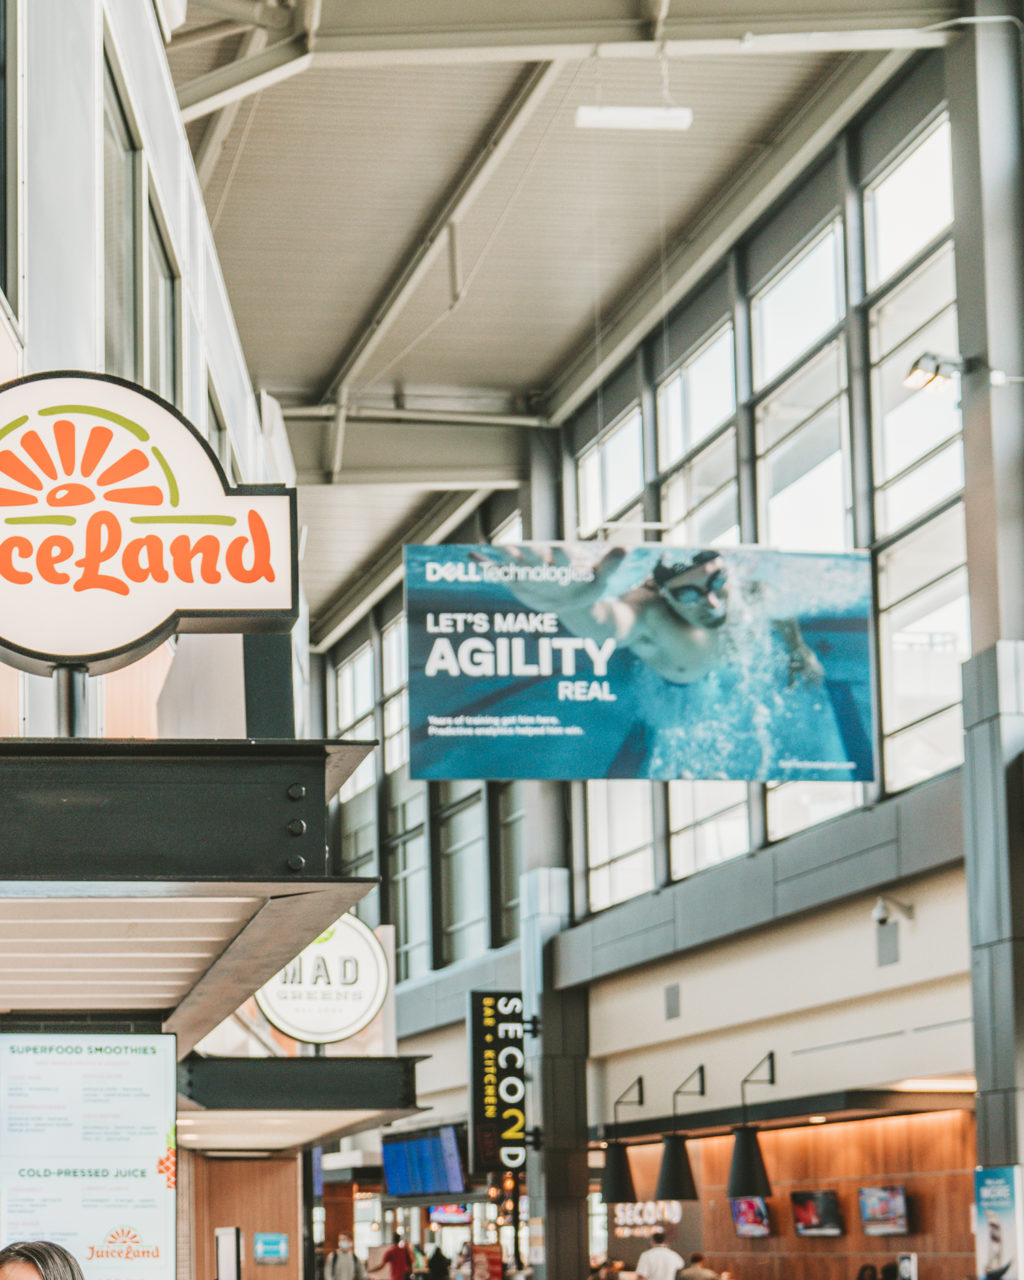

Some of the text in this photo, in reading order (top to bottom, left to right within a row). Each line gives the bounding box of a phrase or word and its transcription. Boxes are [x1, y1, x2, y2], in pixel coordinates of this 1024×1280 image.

[480, 561, 595, 585] Technologies
[426, 613, 558, 633] LET'S MAKE
[424, 637, 617, 677] AGILITY
[557, 680, 617, 701] REAL
[482, 996, 496, 1027] BAR
[9, 1045, 157, 1055] SUPERFOOD SMOOTHIES
[483, 1050, 497, 1118] KITCHEN
[18, 1168, 147, 1178] COLD-PRESSED JUICE
[85, 1245, 160, 1261] JuiceLand
